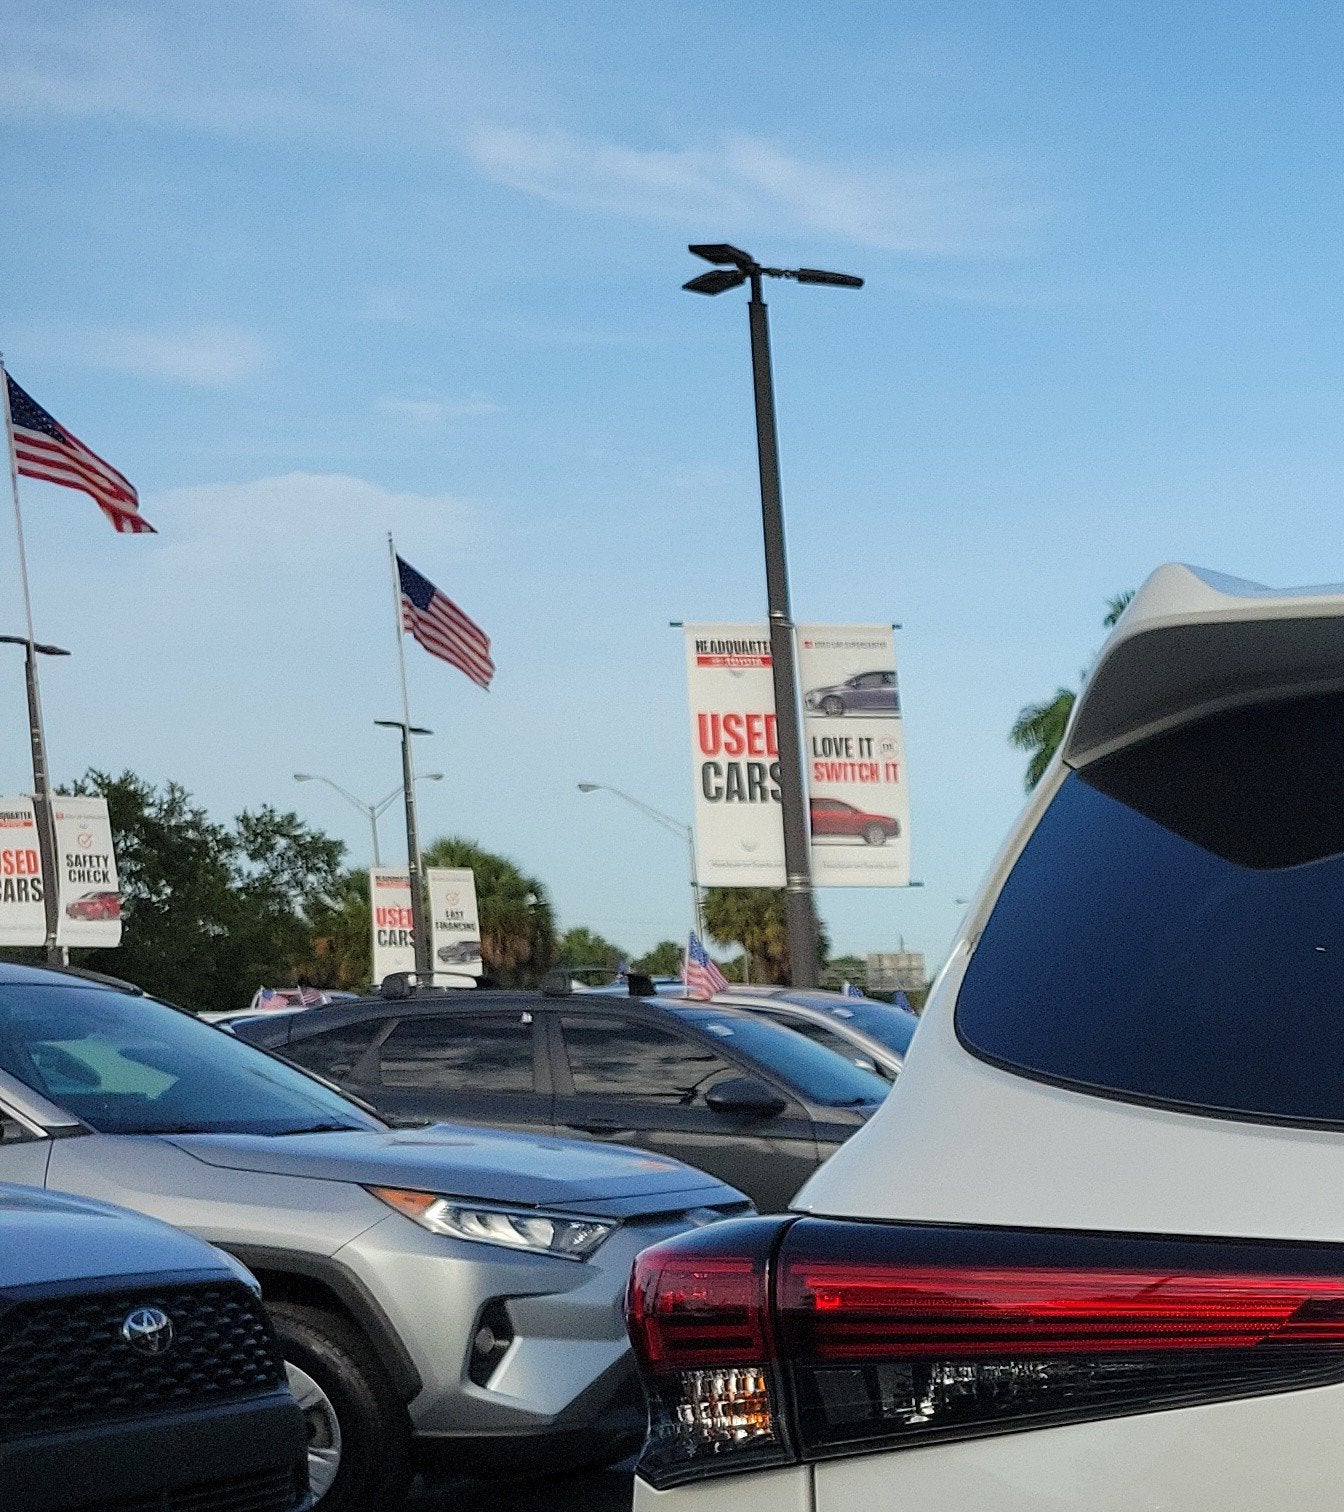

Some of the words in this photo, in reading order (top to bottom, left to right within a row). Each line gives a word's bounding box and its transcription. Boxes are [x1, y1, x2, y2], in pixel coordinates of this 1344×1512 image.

[696, 639, 772, 655] HEADQUARTE
[812, 736, 852, 758] LOVE
[859, 737, 875, 758] IT
[813, 762, 878, 783] SWITCH
[885, 762, 899, 783] IT
[0, 850, 39, 875] SED
[66, 854, 109, 868] SAFETY
[69, 870, 111, 883] CHECK
[0, 878, 44, 903] ARS
